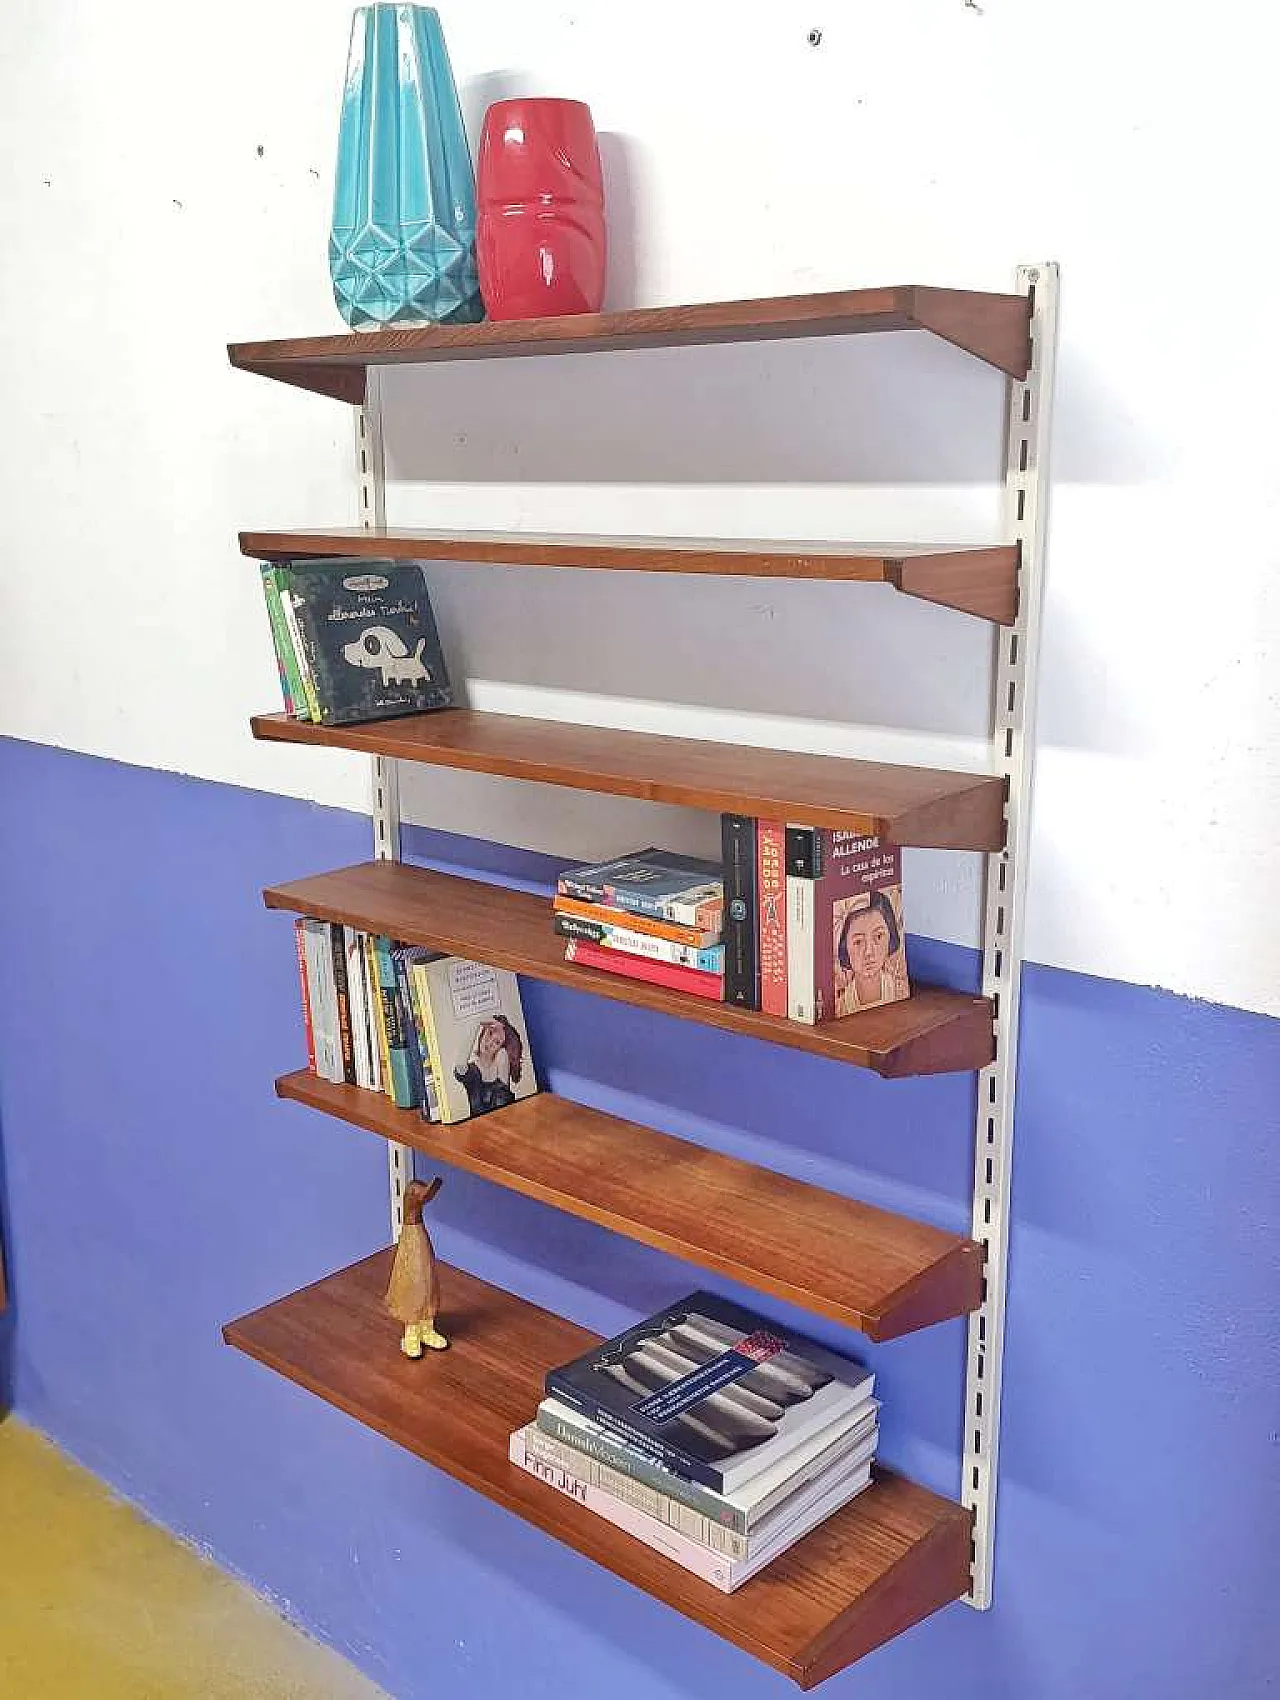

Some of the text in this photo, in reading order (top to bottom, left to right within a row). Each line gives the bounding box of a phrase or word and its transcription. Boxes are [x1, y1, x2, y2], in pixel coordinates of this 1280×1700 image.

[832, 838, 879, 858] ALLENDE
[853, 861, 868, 873] casa
[871, 855, 881, 867] de
[883, 854, 894, 864] los
[524, 1451, 588, 1501] Finn Juhl
